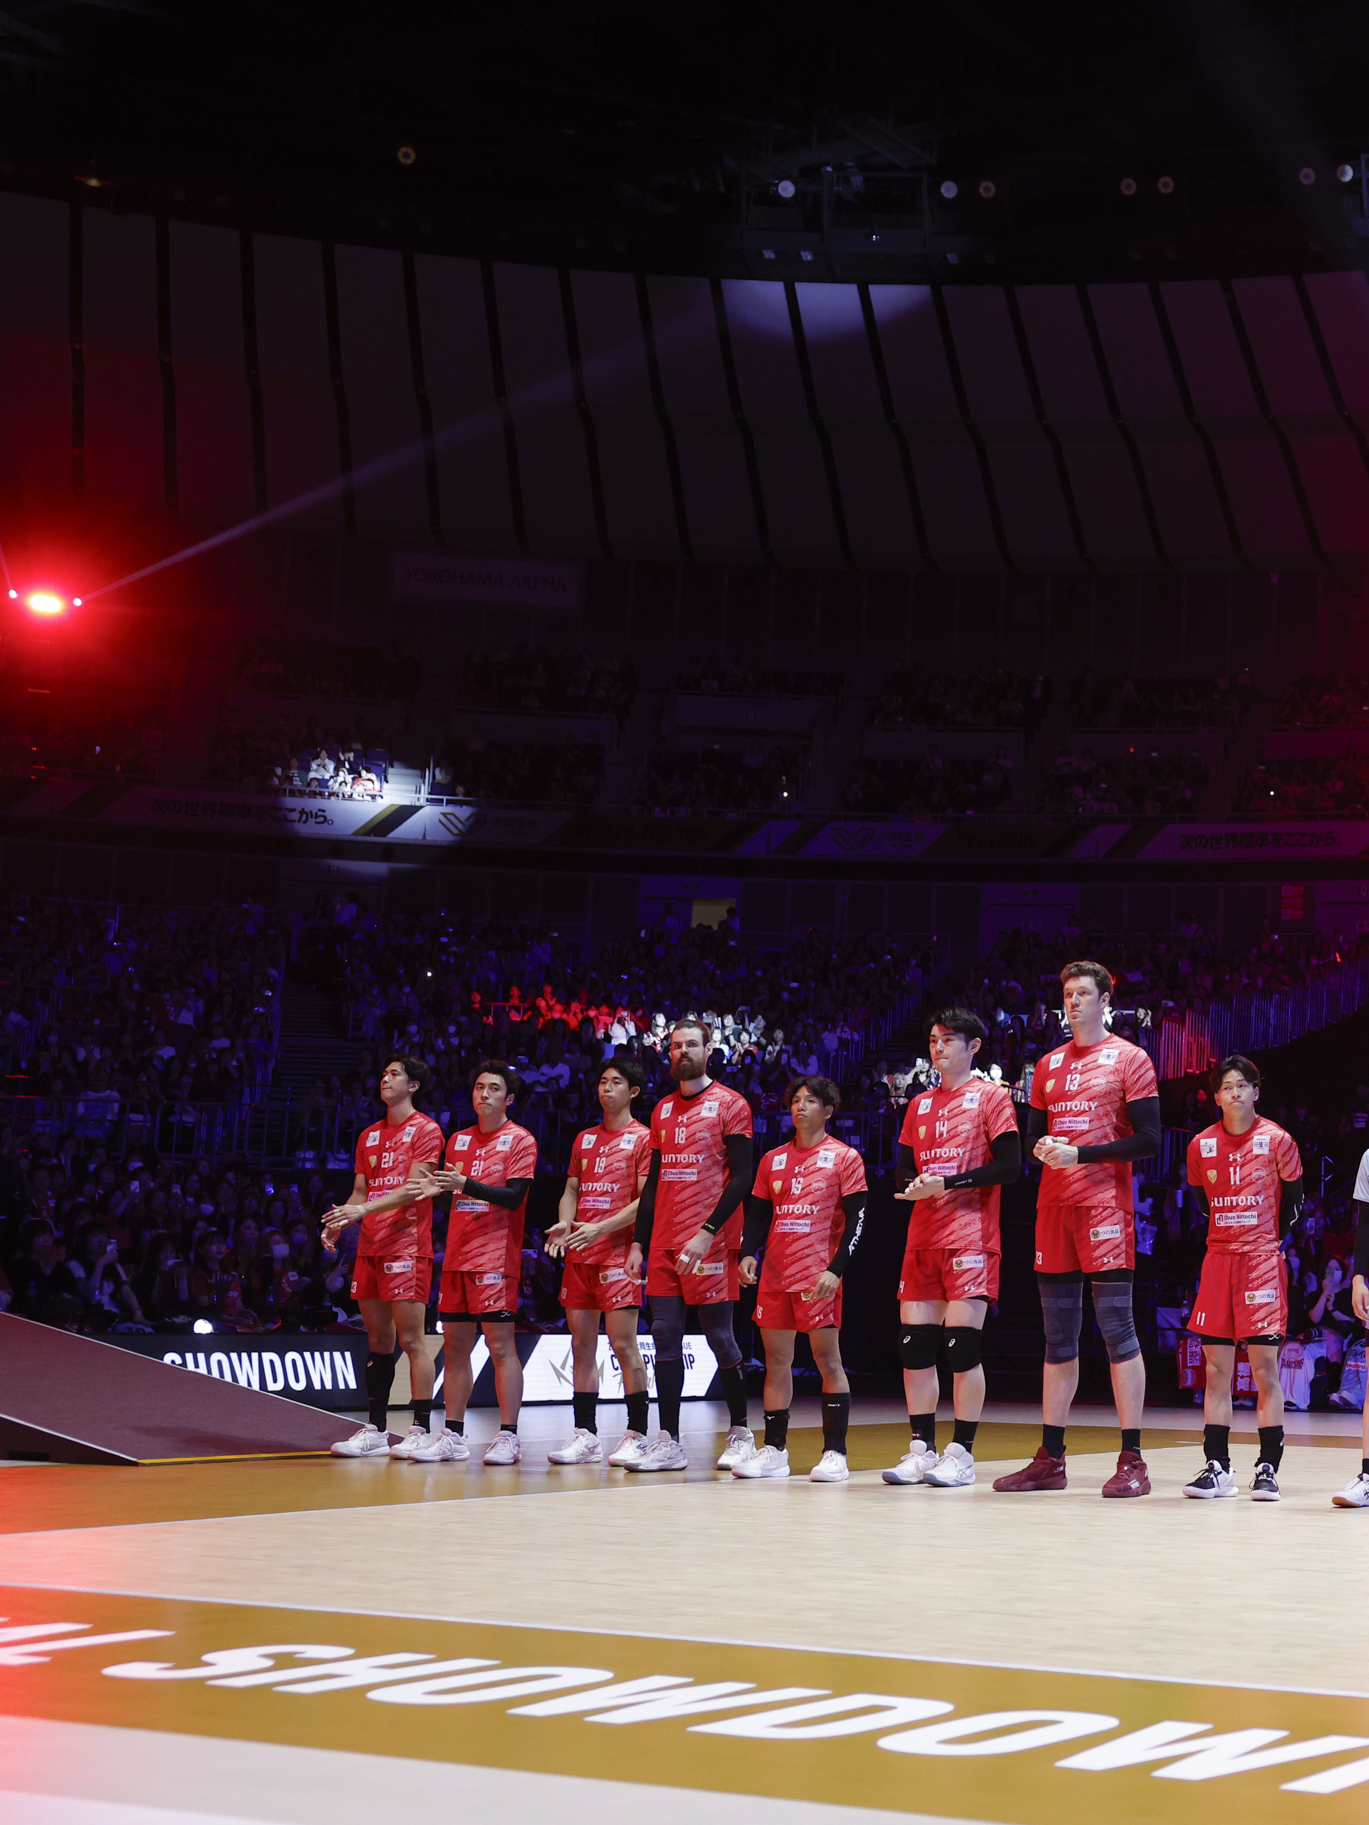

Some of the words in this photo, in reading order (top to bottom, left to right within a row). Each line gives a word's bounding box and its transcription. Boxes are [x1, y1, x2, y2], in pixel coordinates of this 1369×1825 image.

[1064, 1073, 1080, 1091] 13
[674, 1126, 686, 1144] 18
[935, 1120, 948, 1138] 14
[593, 1156, 606, 1174] 19
[661, 1153, 706, 1164] UNTORY
[470, 1160, 484, 1176] 21
[1229, 1166, 1241, 1185] 11
[790, 1177, 804, 1195] 15
[1224, 1213, 1236, 1221] Chuo
[1196, 1311, 1206, 1327] 11
[163, 1350, 358, 1392] HOWDOWN
